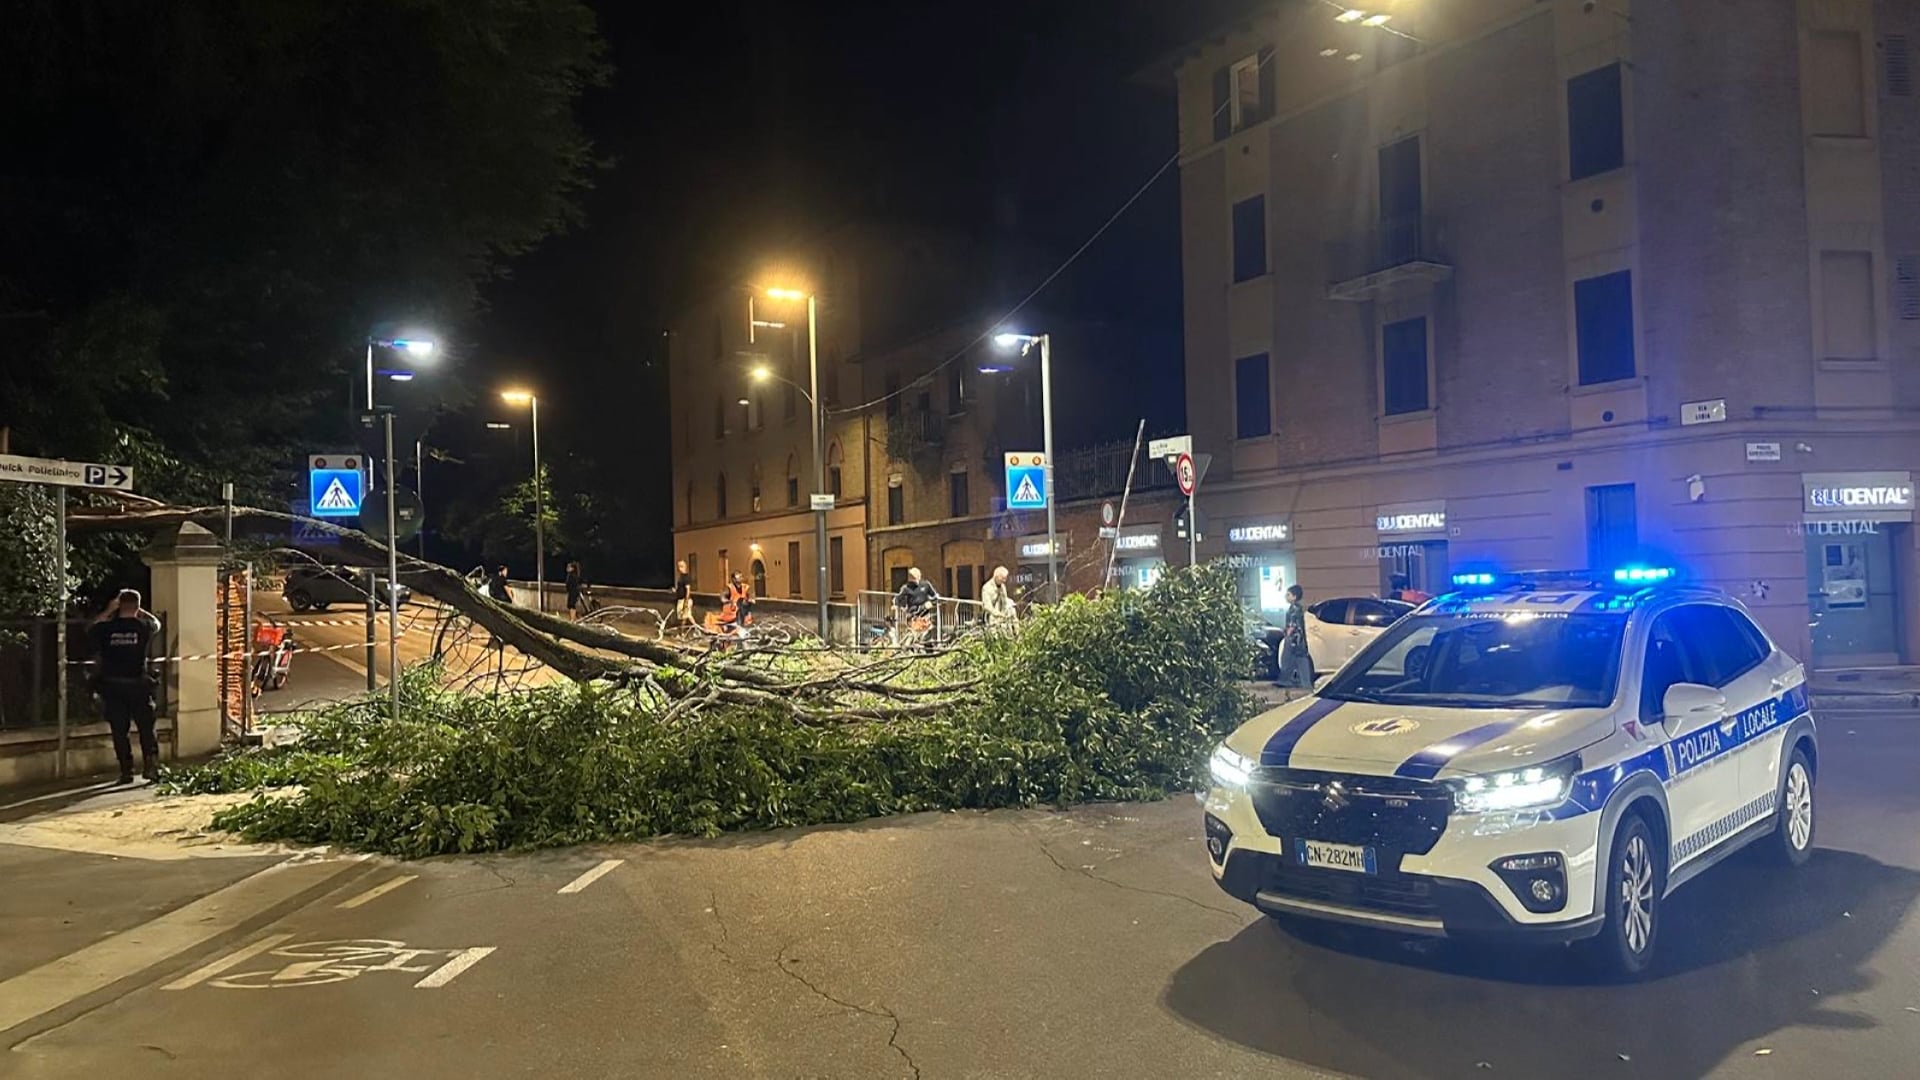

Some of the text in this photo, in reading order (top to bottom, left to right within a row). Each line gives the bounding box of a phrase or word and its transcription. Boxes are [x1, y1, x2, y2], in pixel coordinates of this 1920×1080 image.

[28, 464, 80, 478] Policlinico
[1810, 486, 1909, 506] BLUDENTAL
[1377, 512, 1445, 530] BLUDENTAL
[1679, 728, 1721, 768] POLIZIA
[1743, 703, 1777, 738] LOCALE
